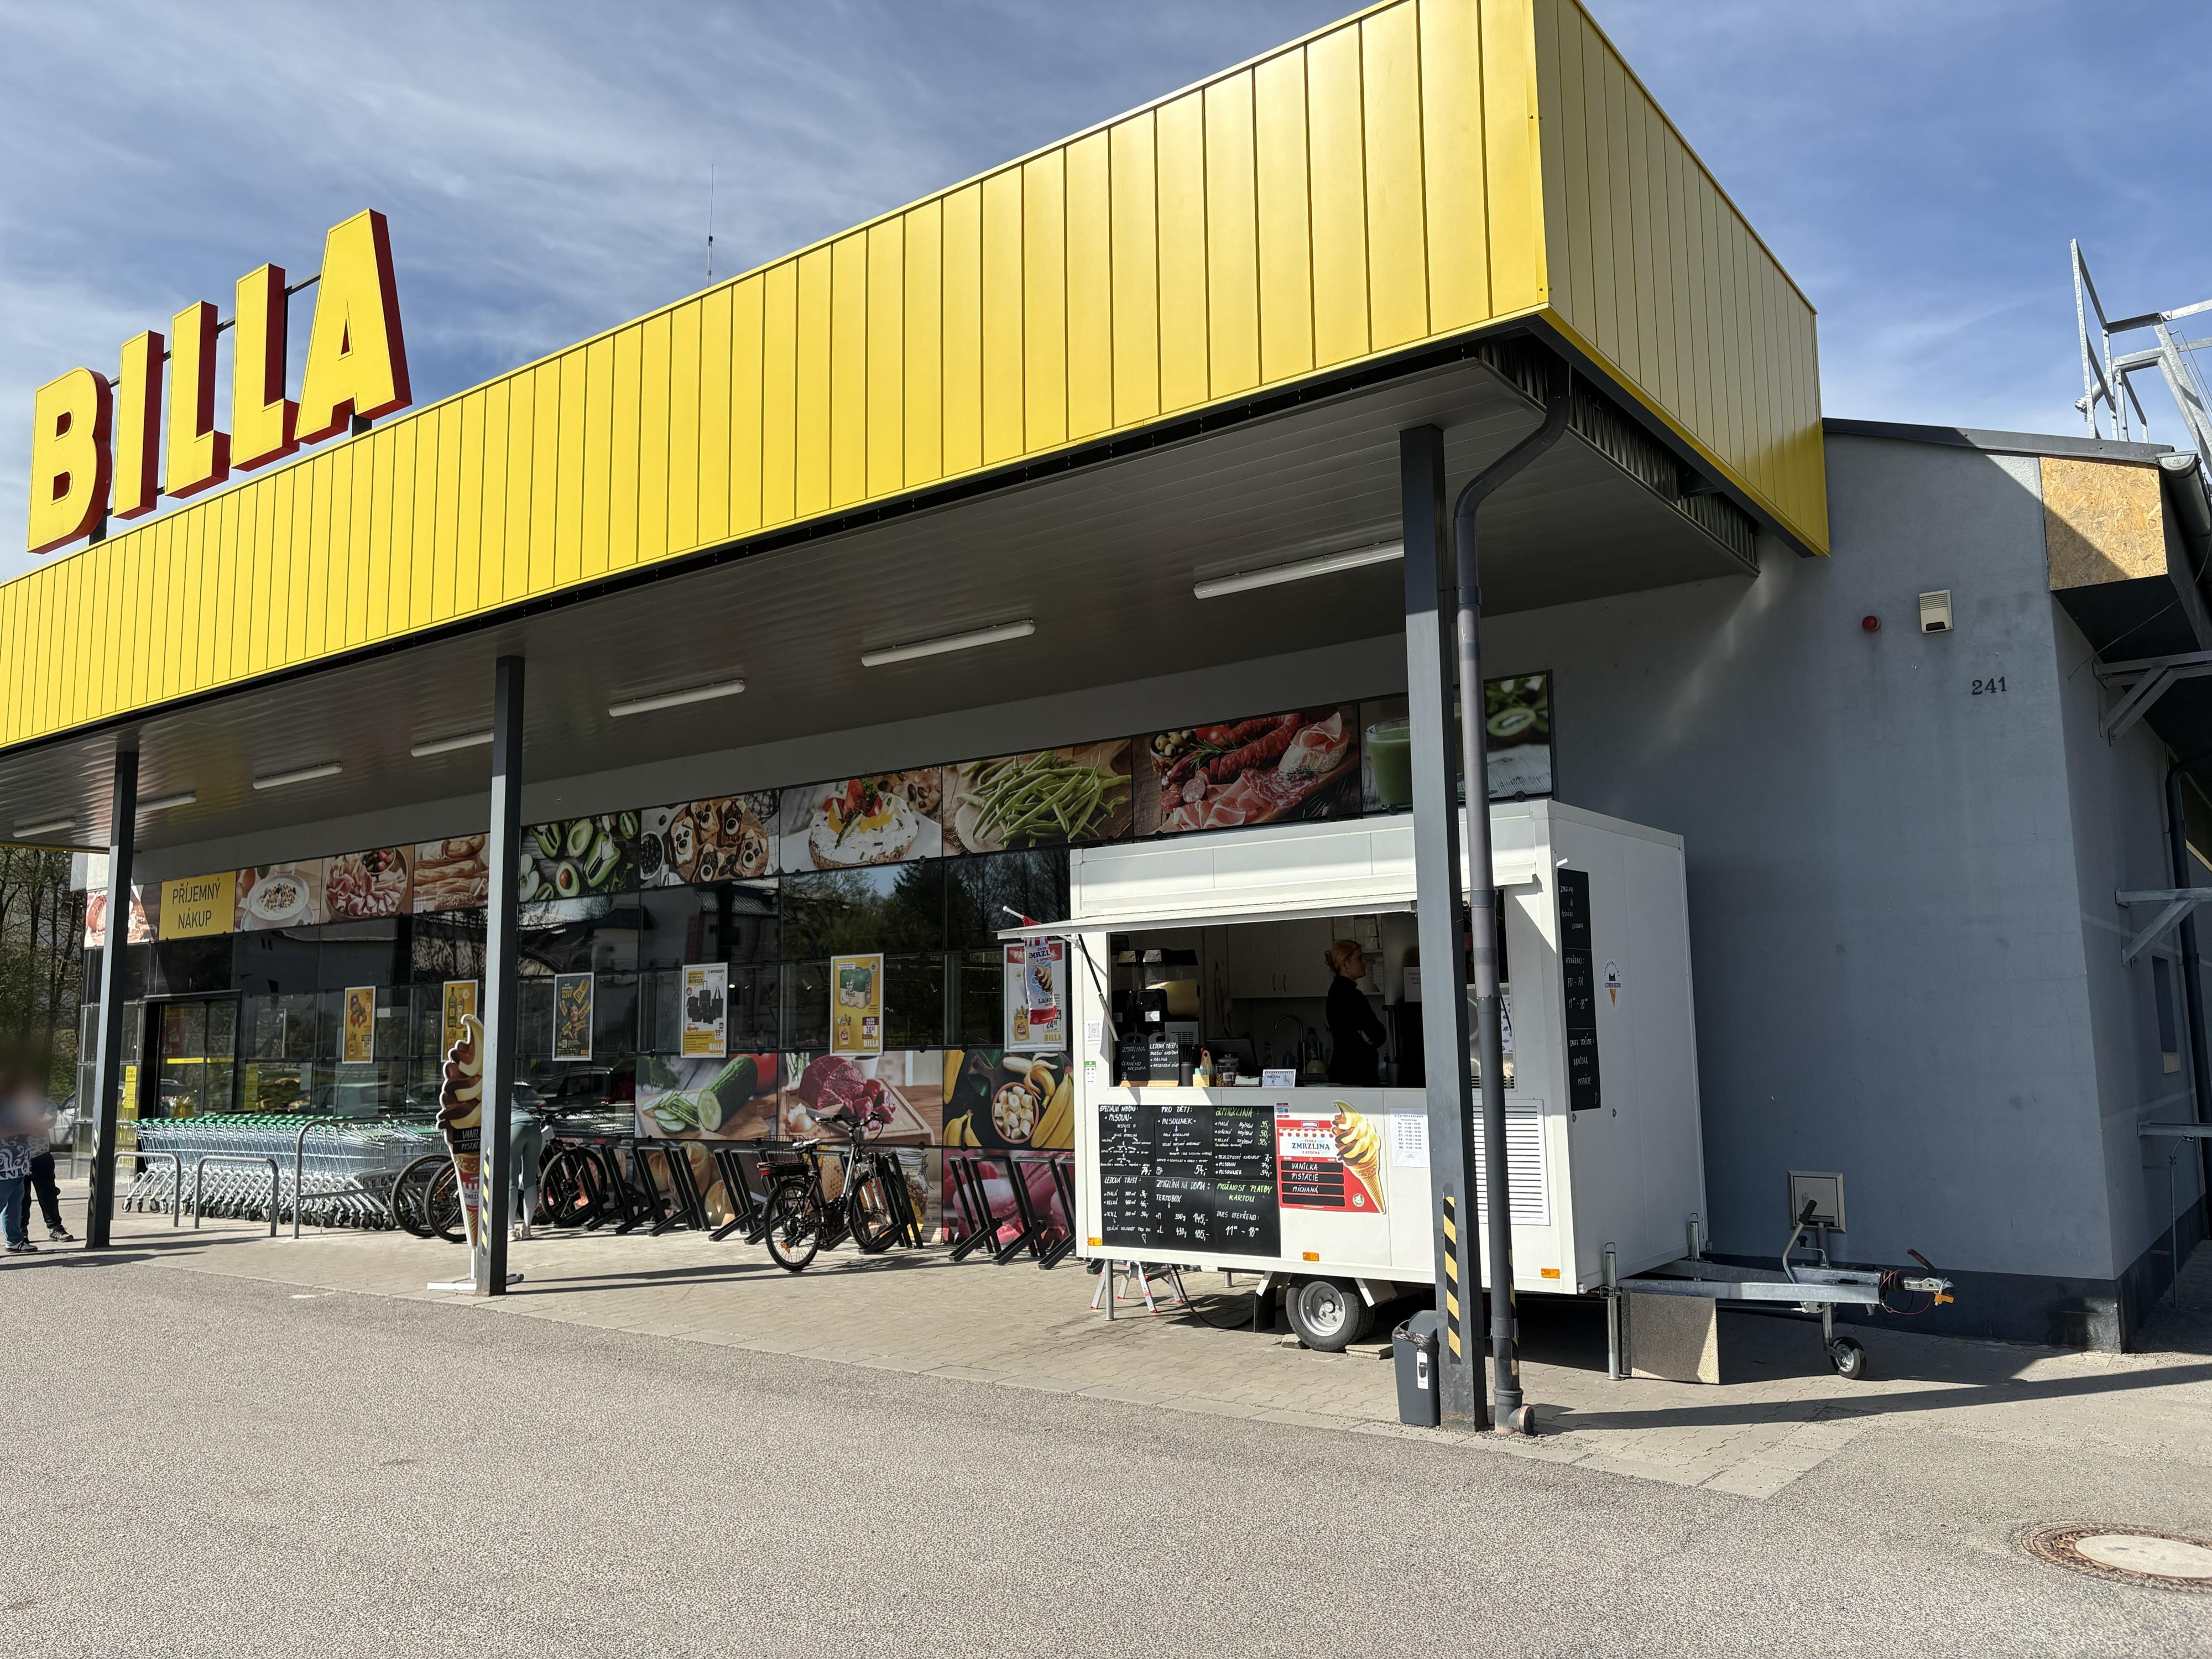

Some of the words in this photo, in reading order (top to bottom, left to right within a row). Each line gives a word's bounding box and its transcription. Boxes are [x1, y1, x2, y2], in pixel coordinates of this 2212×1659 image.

[27, 208, 411, 554] BILLA
[1972, 676, 2006, 695] 241
[173, 878, 221, 905] PŘÍJEMNÝ
[178, 907, 212, 930] NÁKUP
[863, 1039, 879, 1047] BILLA
[1044, 1034, 1062, 1042] BILLA
[1217, 1181, 1246, 1192] MOŽNOST
[1250, 1185, 1273, 1194] PLATBY
